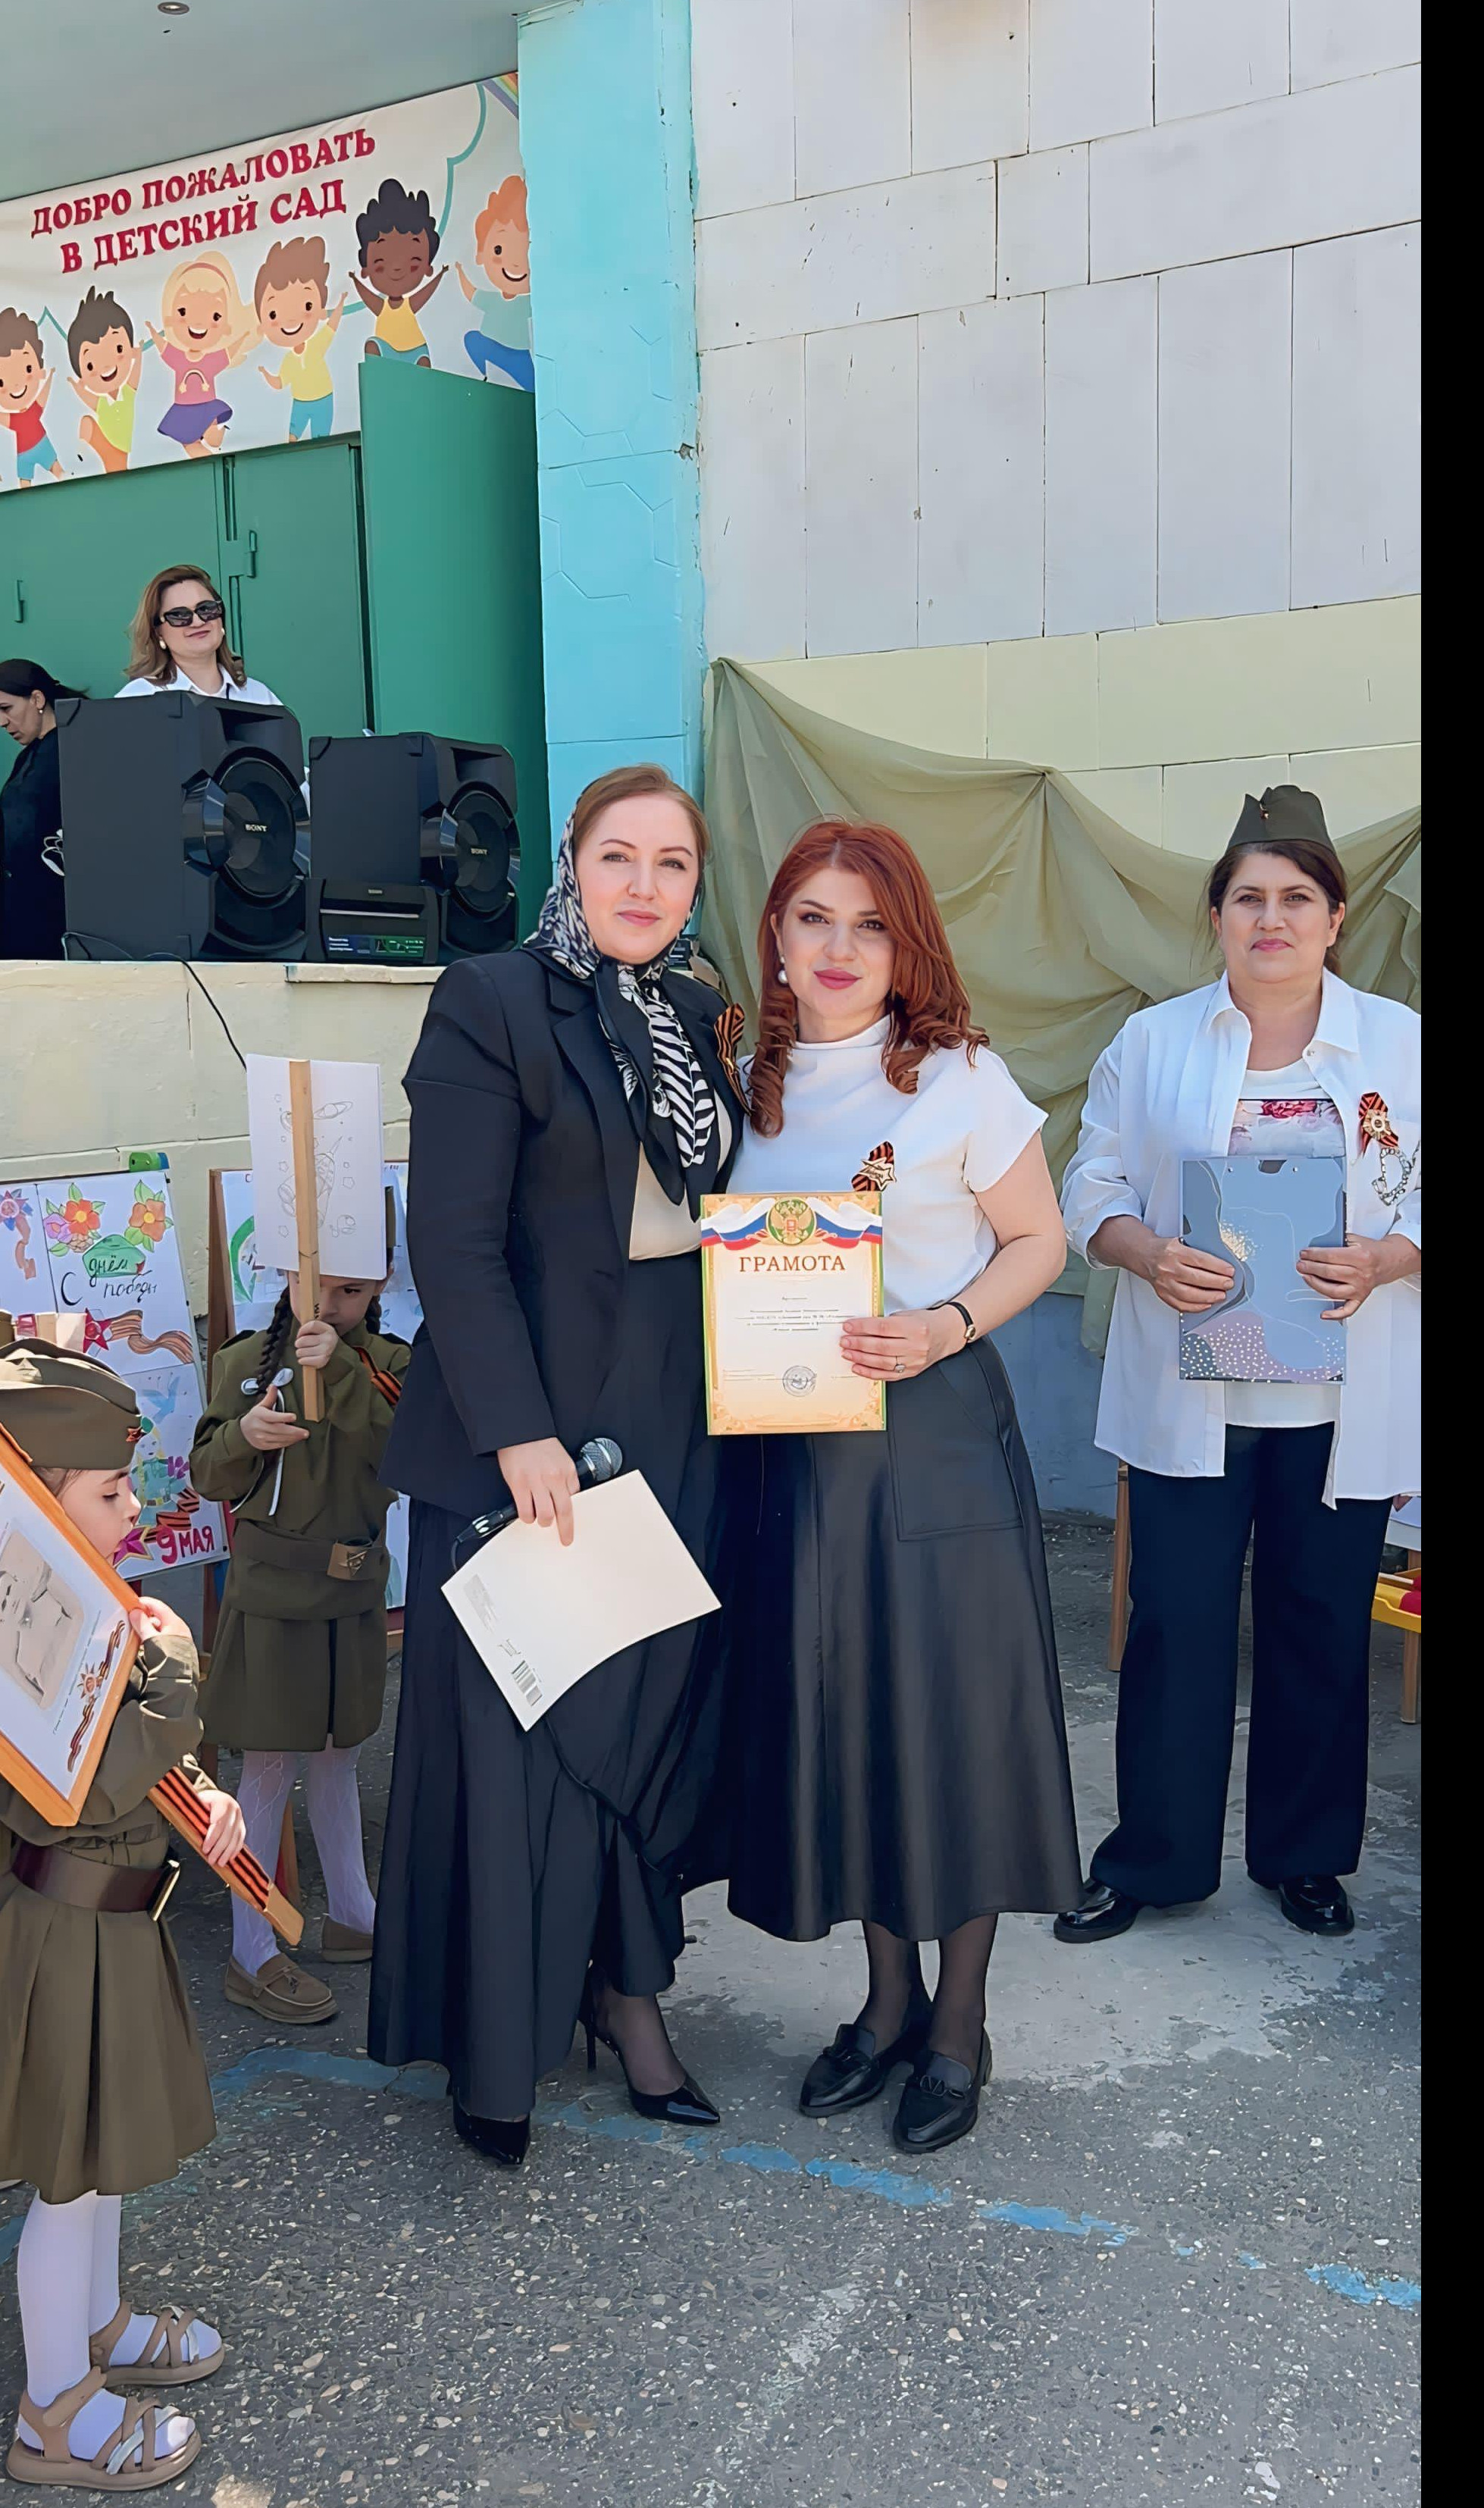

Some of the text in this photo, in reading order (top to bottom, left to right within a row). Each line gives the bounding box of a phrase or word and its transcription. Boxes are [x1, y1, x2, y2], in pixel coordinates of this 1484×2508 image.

[31, 128, 376, 237] ДОБРО ПОЖАЛОВАТЬ
[61, 179, 347, 274] В ДЕТСКИЙ САД
[739, 1255, 846, 1272] ГРАМОТА
[155, 1524, 215, 1564] 9 МАЯ
